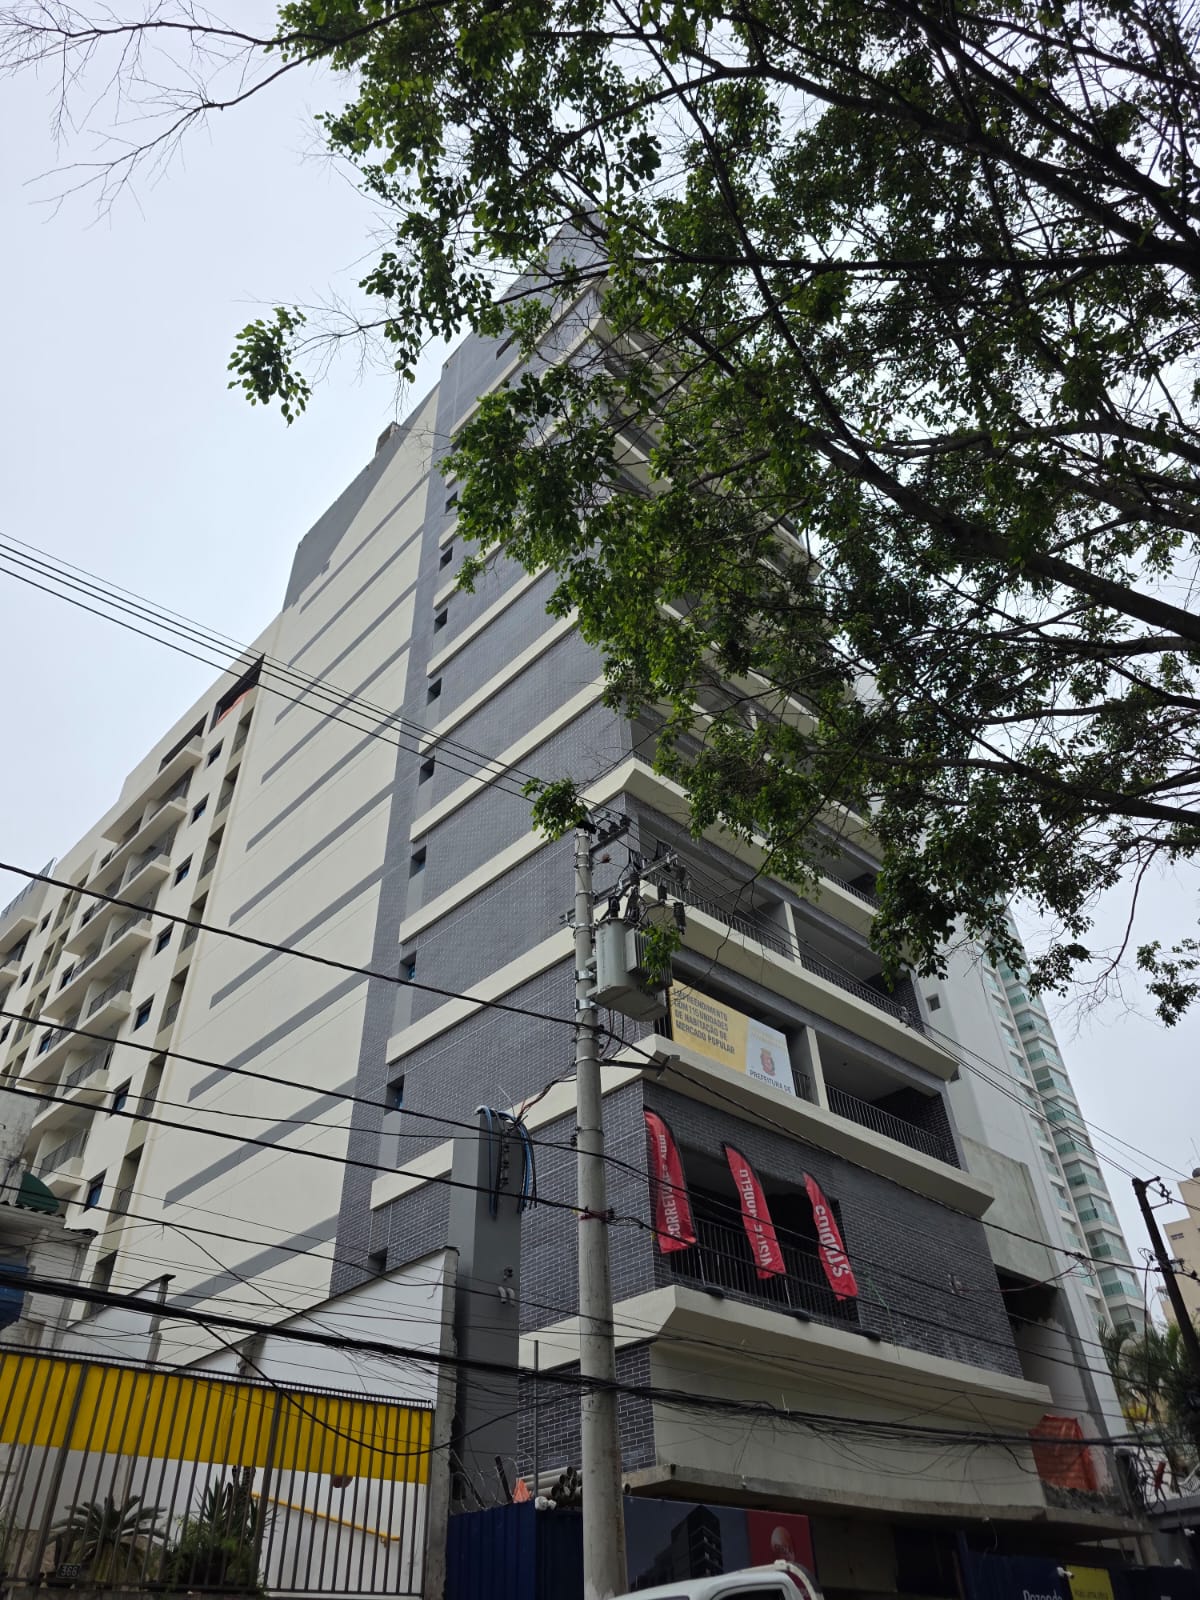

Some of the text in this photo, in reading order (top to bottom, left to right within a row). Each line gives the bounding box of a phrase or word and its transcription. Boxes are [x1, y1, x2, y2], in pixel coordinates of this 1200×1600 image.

[675, 1008, 684, 1020] DE
[719, 1030, 728, 1042] DE
[676, 1020, 707, 1042] MERCADO
[707, 1033, 735, 1055] POPULAR
[700, 1010, 729, 1032] UNIDADES
[749, 1069, 783, 1089] PREFEITURA
[815, 1204, 850, 1278] STUDIOS
